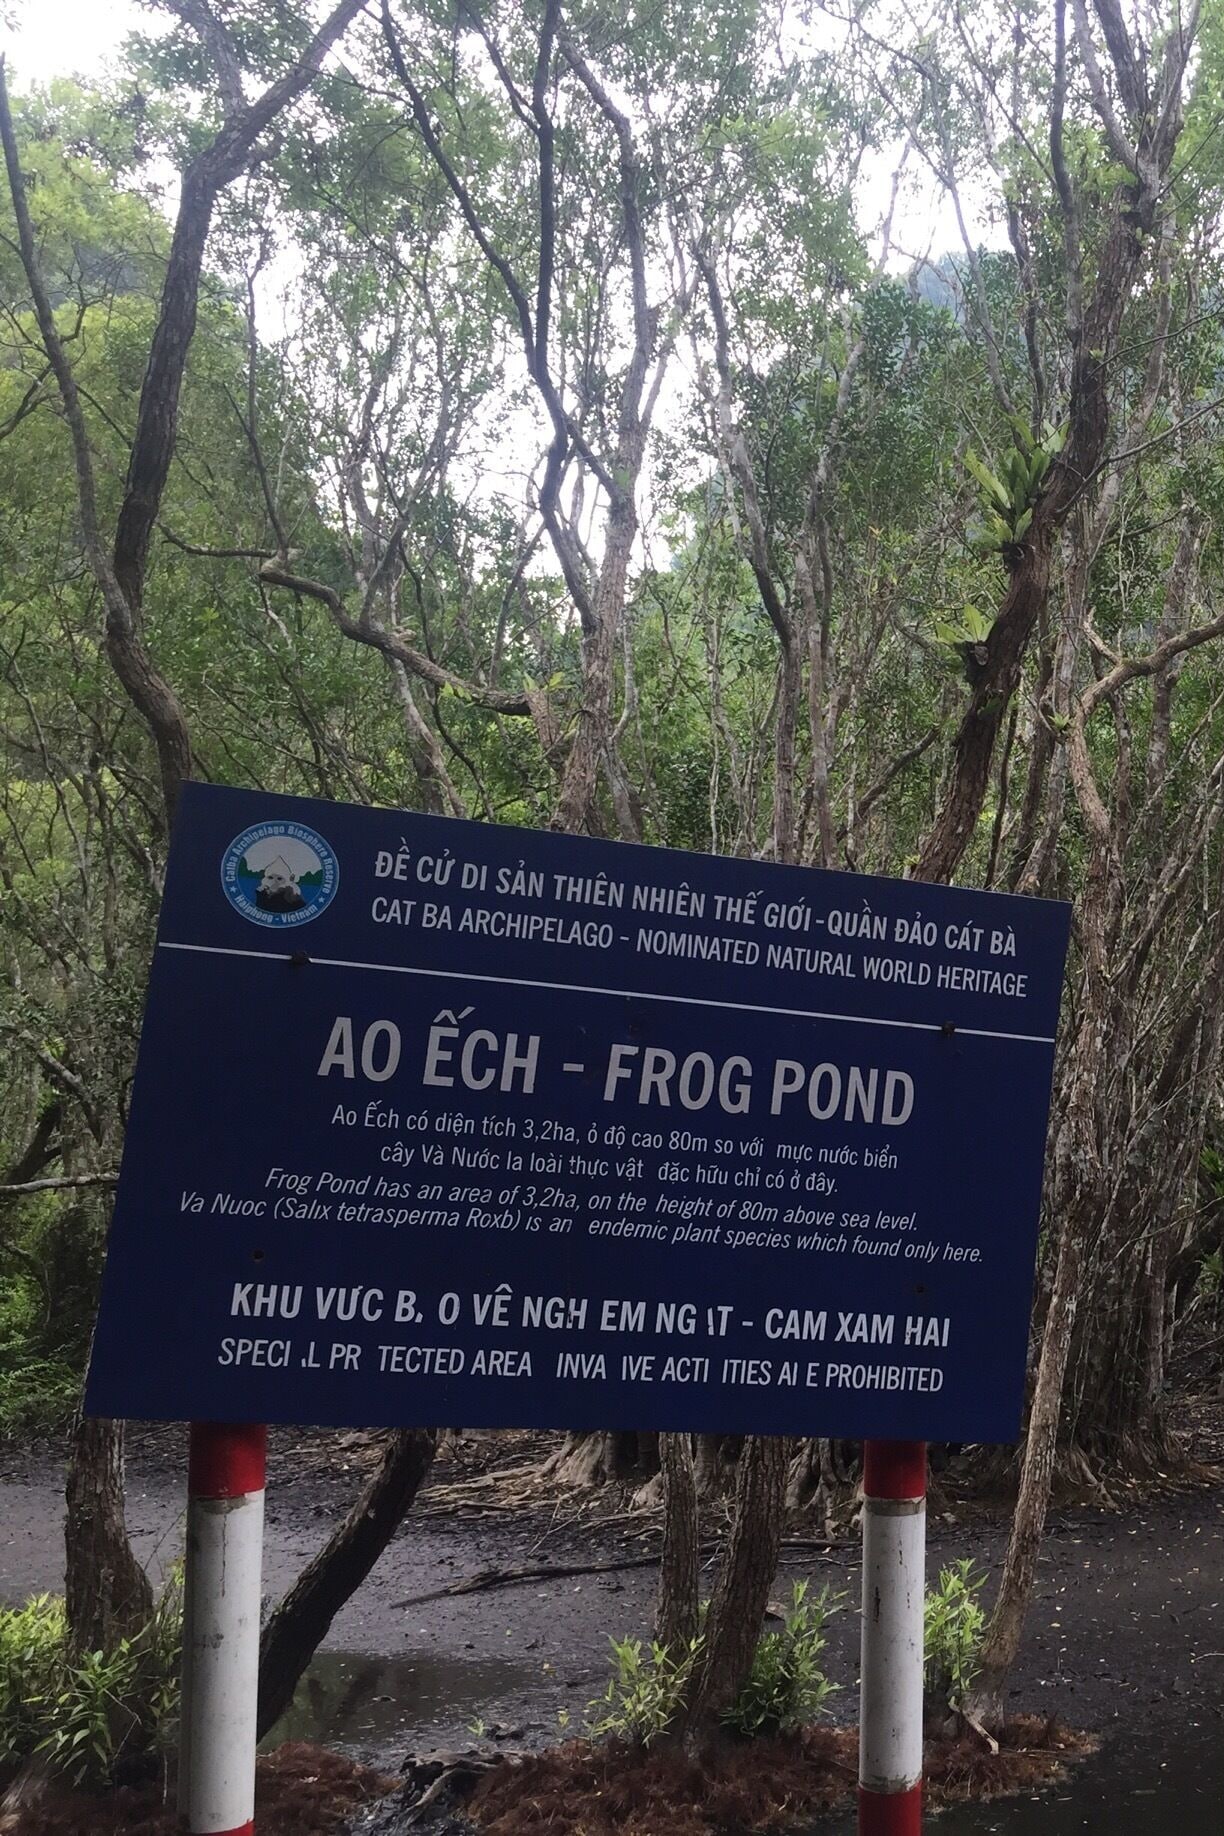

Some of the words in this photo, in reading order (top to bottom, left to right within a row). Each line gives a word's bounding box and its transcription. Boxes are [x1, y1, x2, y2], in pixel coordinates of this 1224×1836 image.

[232, 825, 285, 856] Archipelago
[287, 825, 328, 857] Biosphere
[323, 856, 334, 894] Reserve
[234, 894, 274, 923] Haiphong
[281, 904, 318, 923] Vietnam
[374, 836, 411, 882] ĐỀ
[416, 848, 457, 886] CỬ
[460, 862, 488, 892] DI
[494, 859, 545, 899] SẢN
[552, 871, 625, 909] THIÊN
[631, 881, 706, 919] NHIÊN
[713, 889, 765, 926] THẾ
[893, 911, 938, 947] ĐẢO
[944, 919, 985, 953] CÁT
[989, 924, 1017, 958] BÀ
[371, 896, 417, 926] CAT
[421, 902, 453, 931] BA
[457, 907, 614, 949] ARCHIPELAGO
[635, 927, 760, 966] NOMINATED
[765, 943, 857, 979] NATURAL
[862, 955, 932, 986] WORLD
[936, 964, 1029, 998] HERITAGE
[316, 1016, 402, 1082] AO
[422, 1005, 541, 1094] ẾCH
[602, 1043, 753, 1114] FROG
[769, 1058, 915, 1126] POND
[330, 1103, 358, 1127] Ao
[363, 1099, 400, 1129] Ếch
[406, 1109, 429, 1132] có
[434, 1111, 475, 1137] diện
[481, 1114, 517, 1138] tích
[522, 1118, 580, 1145] 3,2ha,
[603, 1124, 627, 1150] độ
[631, 1131, 663, 1150] cao
[668, 1130, 708, 1153] 80m
[713, 1138, 734, 1155] so
[739, 1136, 765, 1158] với
[776, 1143, 814, 1164] mực
[817, 1144, 859, 1166] nước
[863, 1143, 898, 1169] biển
[380, 1140, 416, 1168] cây
[421, 1143, 445, 1166] Và
[451, 1146, 501, 1170] Nước
[505, 1150, 523, 1172] la
[529, 1151, 564, 1174] loài
[568, 1154, 609, 1180] thực
[615, 1156, 645, 1182] vật
[657, 1161, 690, 1185] đặc
[695, 1163, 729, 1185] hữu
[734, 1166, 762, 1188] chỉ
[764, 1168, 785, 1190] có
[789, 1168, 802, 1191] ở
[804, 1171, 838, 1197] đây.
[180, 1190, 205, 1213] Va
[209, 1192, 268, 1217] Nuoc
[336, 1201, 461, 1229] tetrasperma
[464, 1207, 522, 1232] Roxb)
[548, 1216, 573, 1233] an
[587, 1216, 669, 1241] endemic
[670, 1222, 722, 1245] plant
[723, 1227, 792, 1249] species
[796, 1231, 848, 1253] which
[851, 1234, 903, 1257] found
[904, 1240, 941, 1264] only
[942, 1241, 983, 1263] here.
[264, 1167, 314, 1196] Frog
[315, 1171, 372, 1196] Pond
[372, 1175, 412, 1199] has
[416, 1184, 444, 1201] an
[447, 1186, 493, 1204] area
[498, 1184, 522, 1205] of
[521, 1185, 581, 1213] 3,2ha,
[587, 1194, 612, 1211] on
[616, 1191, 648, 1213] the
[654, 1193, 714, 1220] height
[716, 1199, 738, 1219] of
[738, 1200, 779, 1223] 80m
[782, 1204, 836, 1227] above
[839, 1212, 871, 1229] sea
[874, 1209, 918, 1232] level.
[230, 1282, 304, 1319] KHU
[393, 1289, 461, 1326] BO
[472, 1282, 514, 1327] VÊ
[521, 1295, 647, 1333] NGHEM
[764, 1307, 828, 1342] CAM
[833, 1311, 895, 1345] XAM
[903, 1315, 951, 1348] HAI
[217, 1337, 321, 1369] SPECIL
[328, 1342, 466, 1375] PRTECTED
[469, 1349, 533, 1377] AREA
[555, 1351, 657, 1382] INVAIVE
[660, 1355, 773, 1386] ACTIITIES
[824, 1362, 944, 1393] PROHIBITED
